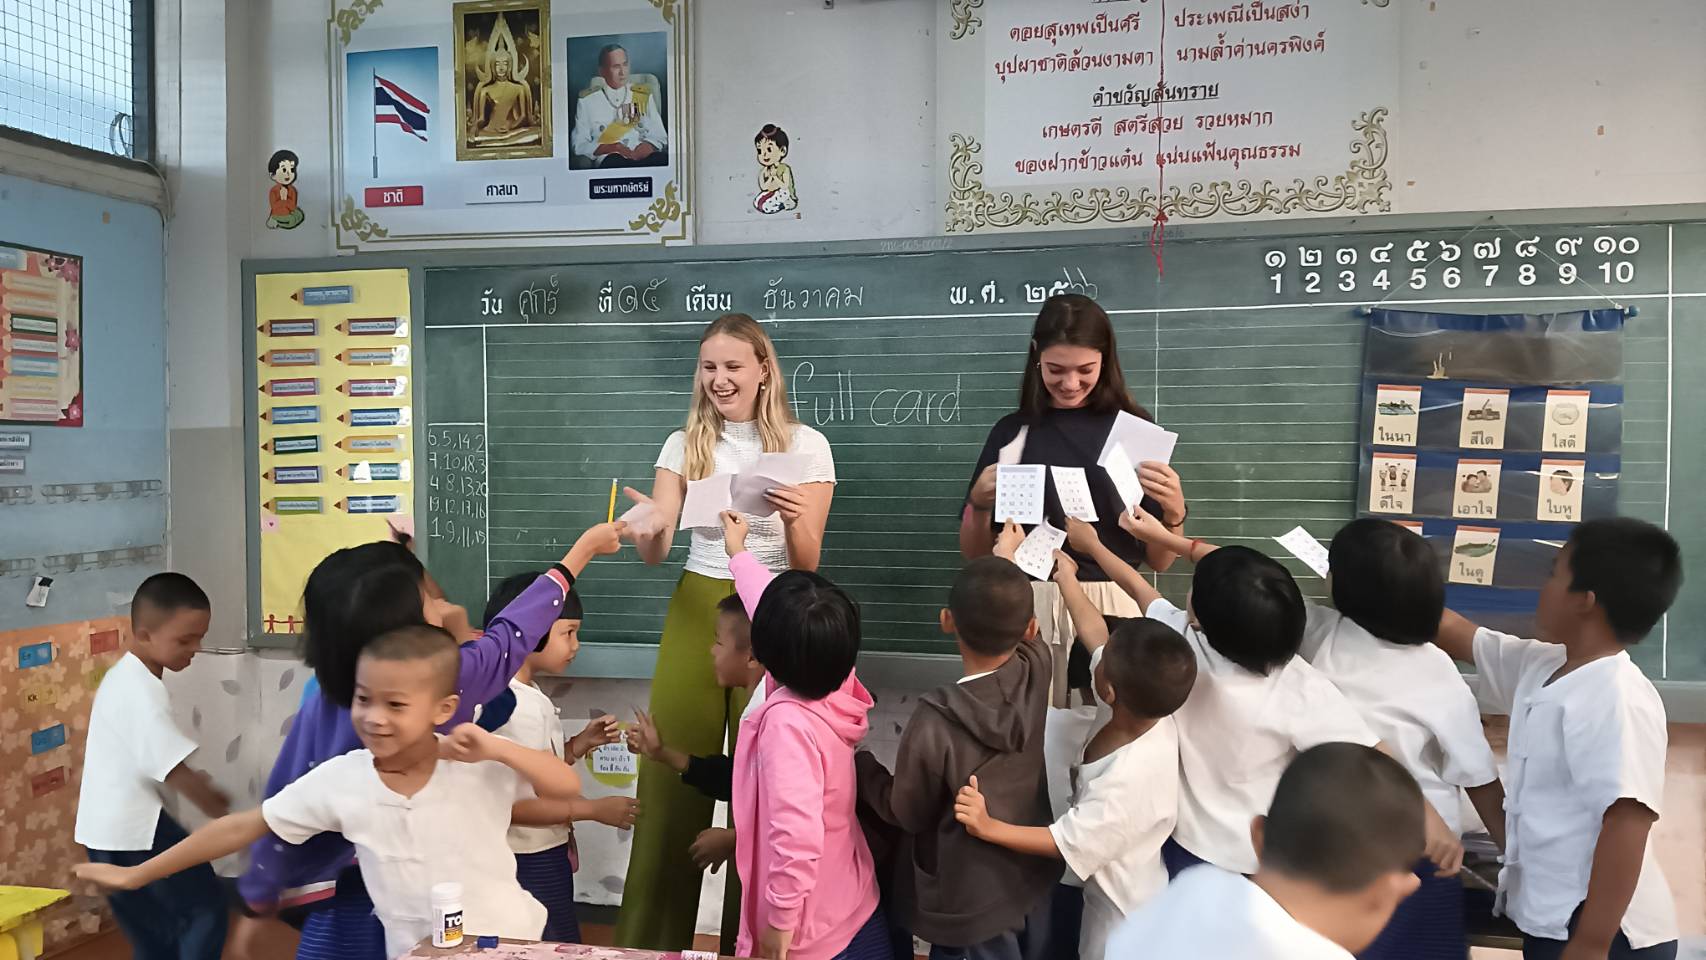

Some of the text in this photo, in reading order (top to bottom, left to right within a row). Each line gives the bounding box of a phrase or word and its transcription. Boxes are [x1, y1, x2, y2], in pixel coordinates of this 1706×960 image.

[1009, 0, 1310, 46] ดอยสุเทพเป็นศรี ประเพณีเป็นสง่า
[1176, 28, 1327, 62] นามล้ำค่านครพิงค์
[1042, 116, 1103, 139] เกษตรดี
[1195, 110, 1273, 130] รวยหมาก
[383, 188, 404, 204] ชาติ
[486, 182, 518, 198] ศาสนา
[593, 181, 650, 194] พระมหากษัตริย์
[1265, 235, 1640, 269] ๑ ๒ ๓ ๔ ๕ ๖ ๗ ๘ ๙ ๑๐
[1270, 260, 1635, 294] 1 2 3 4 5 6 7 8 9 10
[481, 288, 503, 315] วัน
[686, 284, 732, 312] เดือน
[763, 277, 864, 310] ธันวาคม
[788, 361, 961, 426] full card
